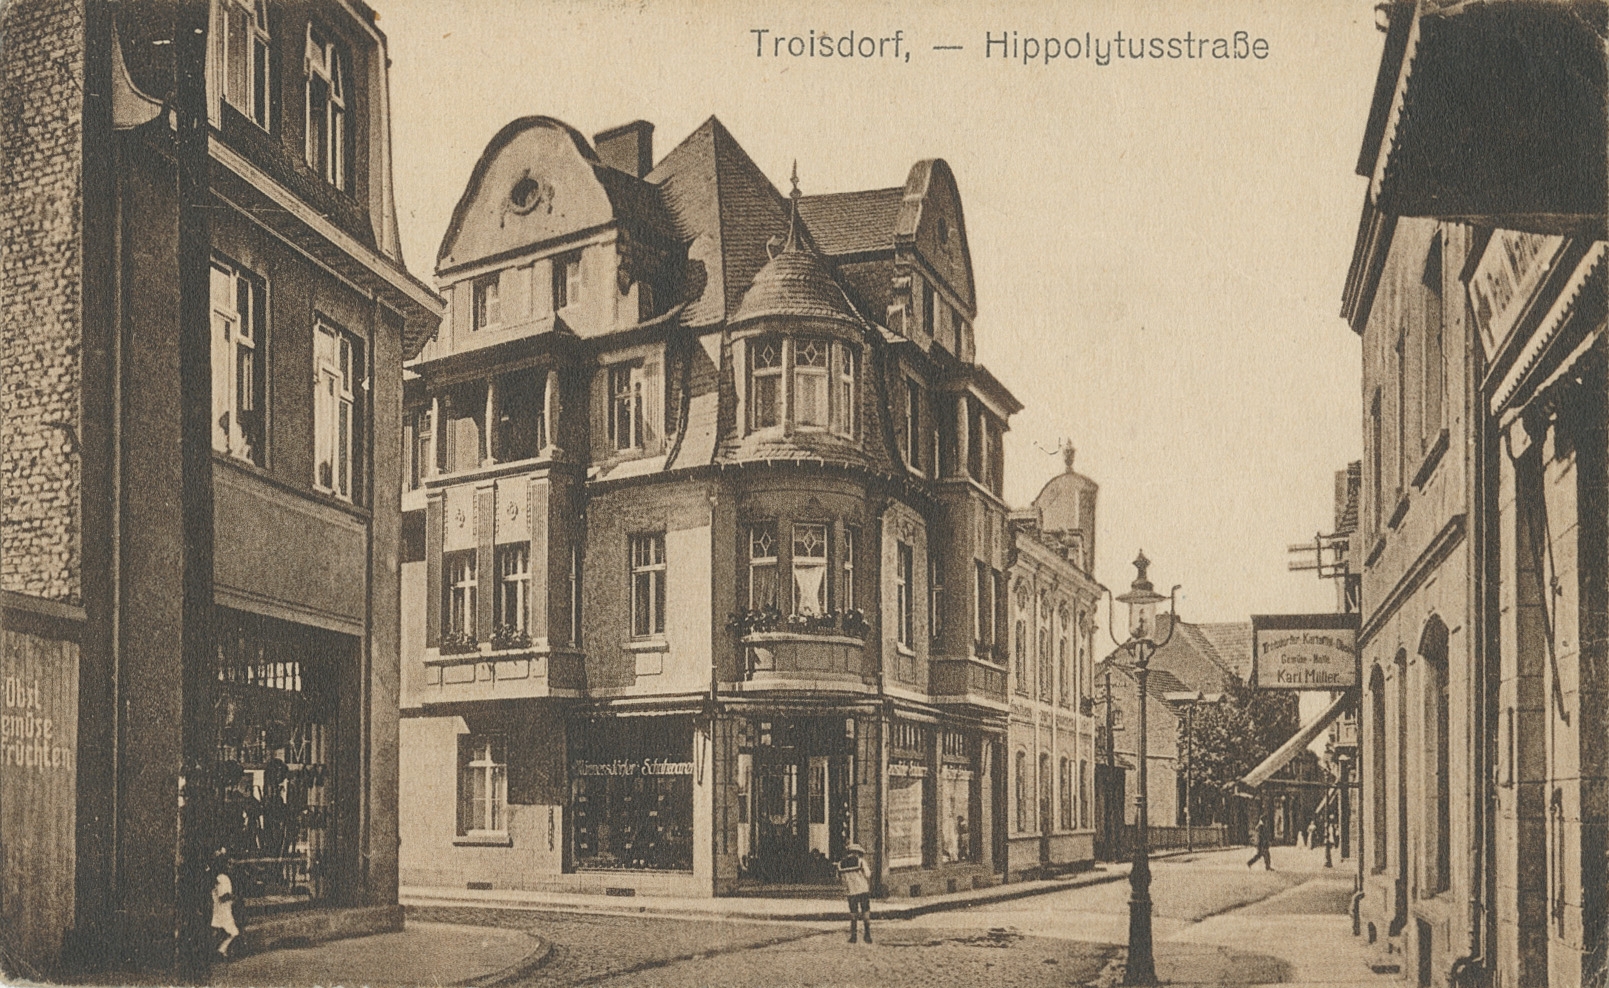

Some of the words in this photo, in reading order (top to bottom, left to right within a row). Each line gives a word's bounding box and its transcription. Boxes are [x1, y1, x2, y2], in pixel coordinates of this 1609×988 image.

[1277, 669, 1302, 684] Karl
[6, 676, 42, 709] Obst
[0, 710, 53, 739] emüse
